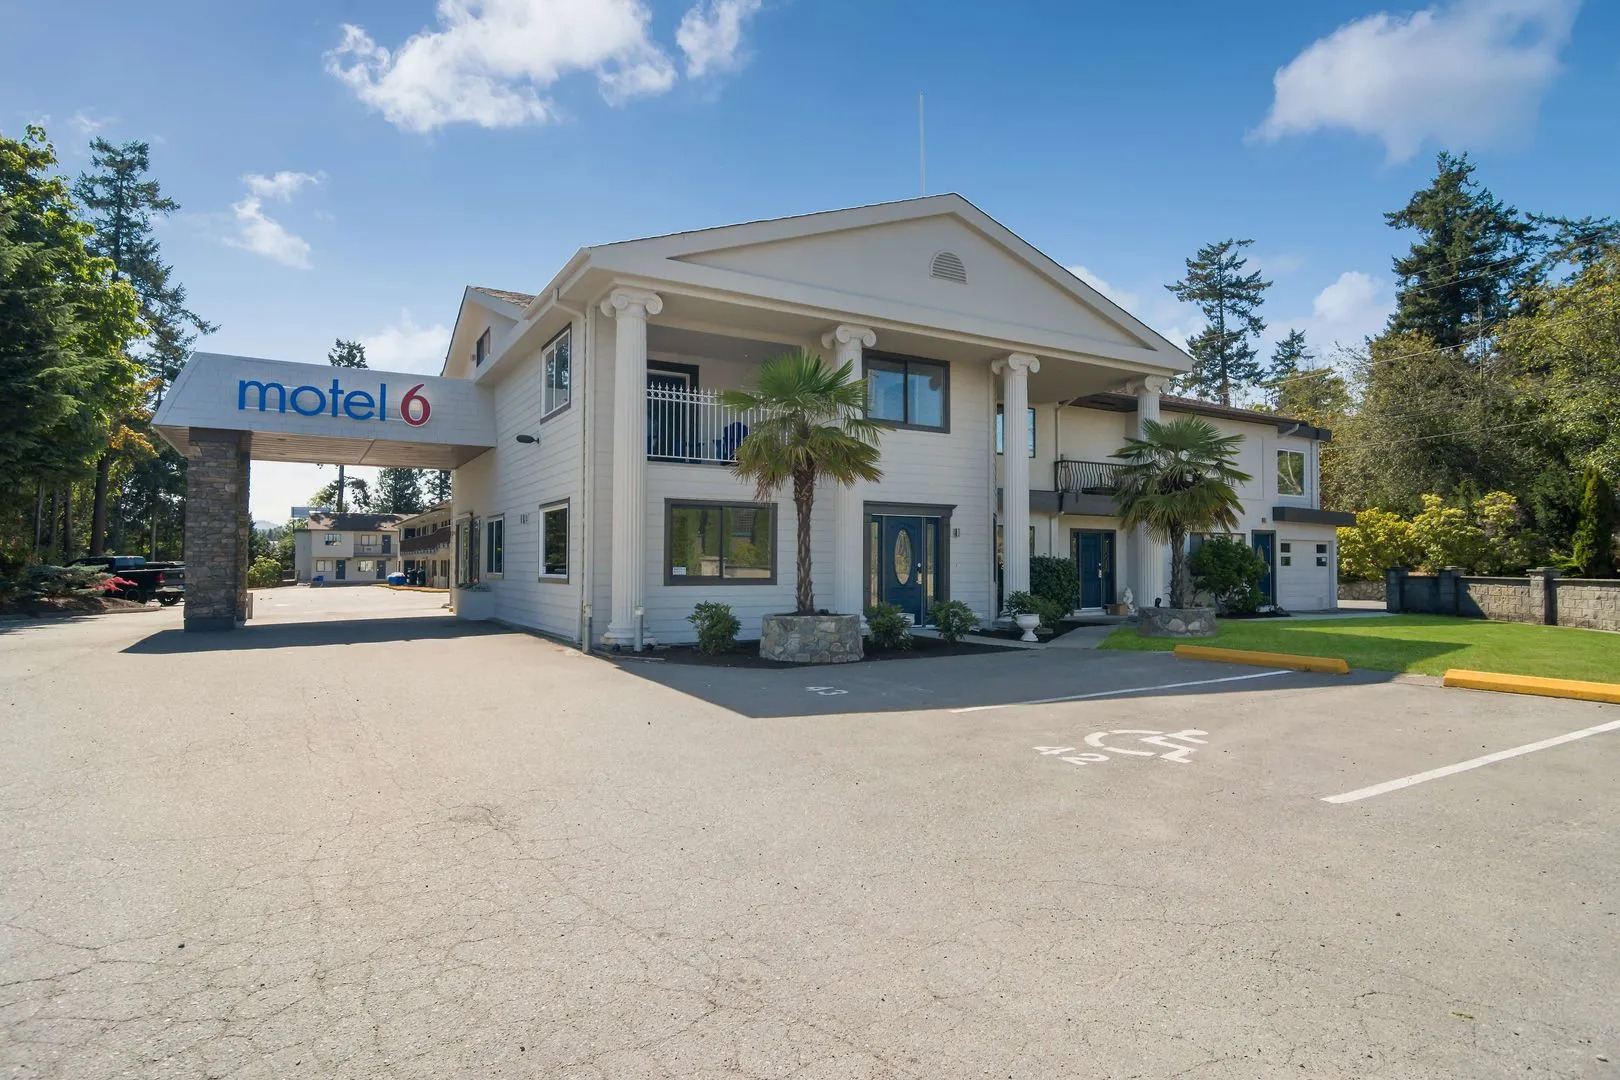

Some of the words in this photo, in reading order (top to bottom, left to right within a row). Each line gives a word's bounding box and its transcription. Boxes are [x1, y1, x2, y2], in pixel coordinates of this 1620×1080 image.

[238, 379, 387, 421] motel
[400, 383, 431, 428] 6
[1032, 746, 1110, 765] 42
